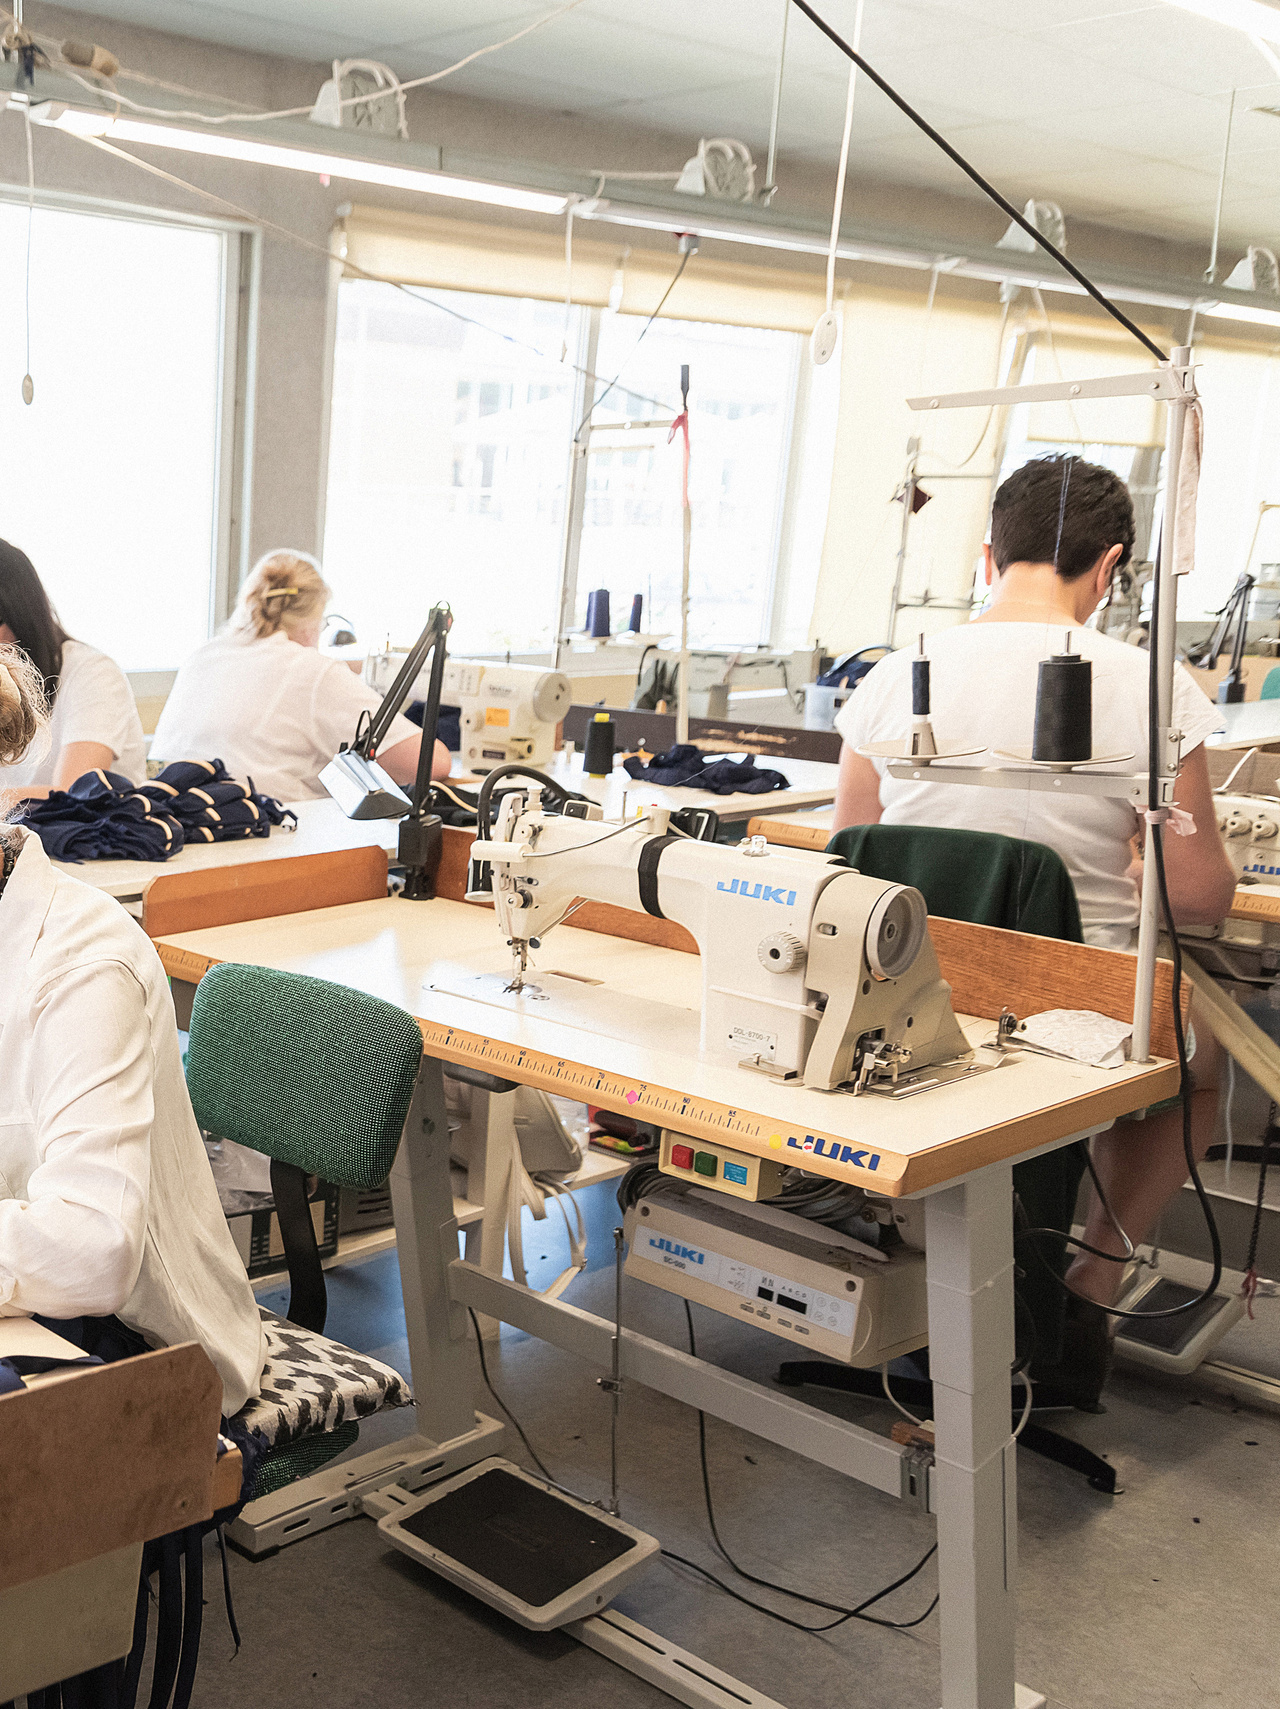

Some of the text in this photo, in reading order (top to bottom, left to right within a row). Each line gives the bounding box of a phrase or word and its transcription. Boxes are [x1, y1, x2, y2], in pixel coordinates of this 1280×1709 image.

[717, 879, 797, 906] JUKI
[787, 1135, 881, 1171] JUKI
[649, 1238, 704, 1265] JUKI
